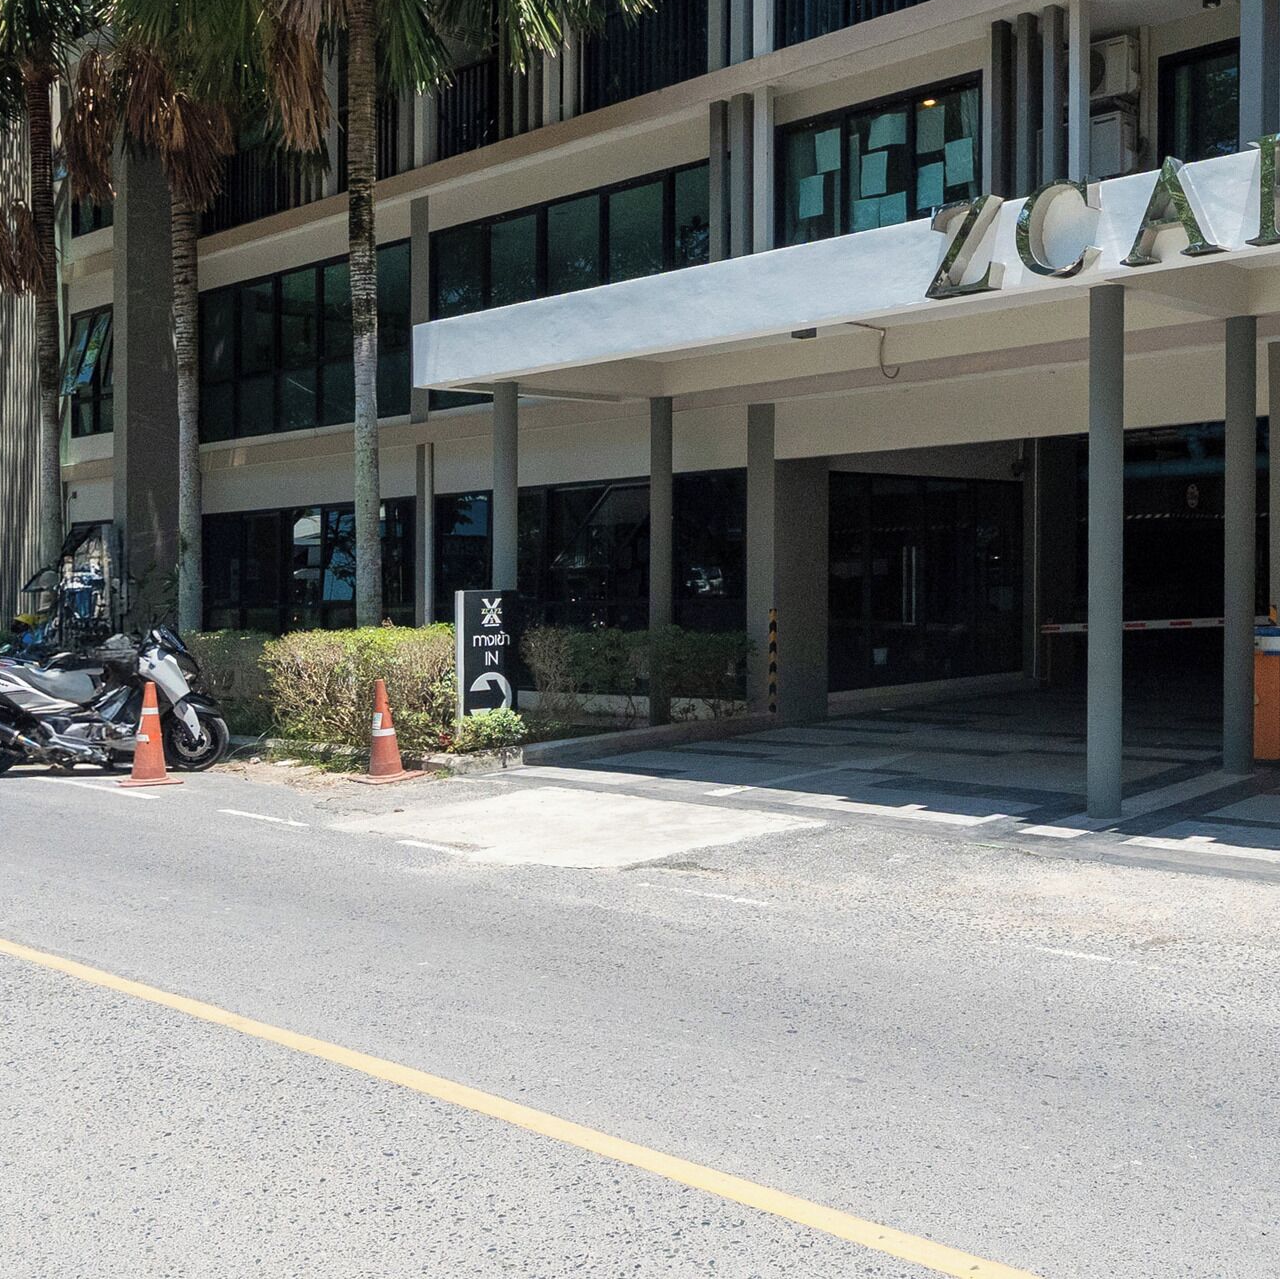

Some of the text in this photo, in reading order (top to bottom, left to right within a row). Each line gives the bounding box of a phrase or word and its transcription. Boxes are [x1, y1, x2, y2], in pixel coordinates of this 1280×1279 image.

[473, 631, 510, 647] ทางเข้า
[485, 650, 498, 666] IN
